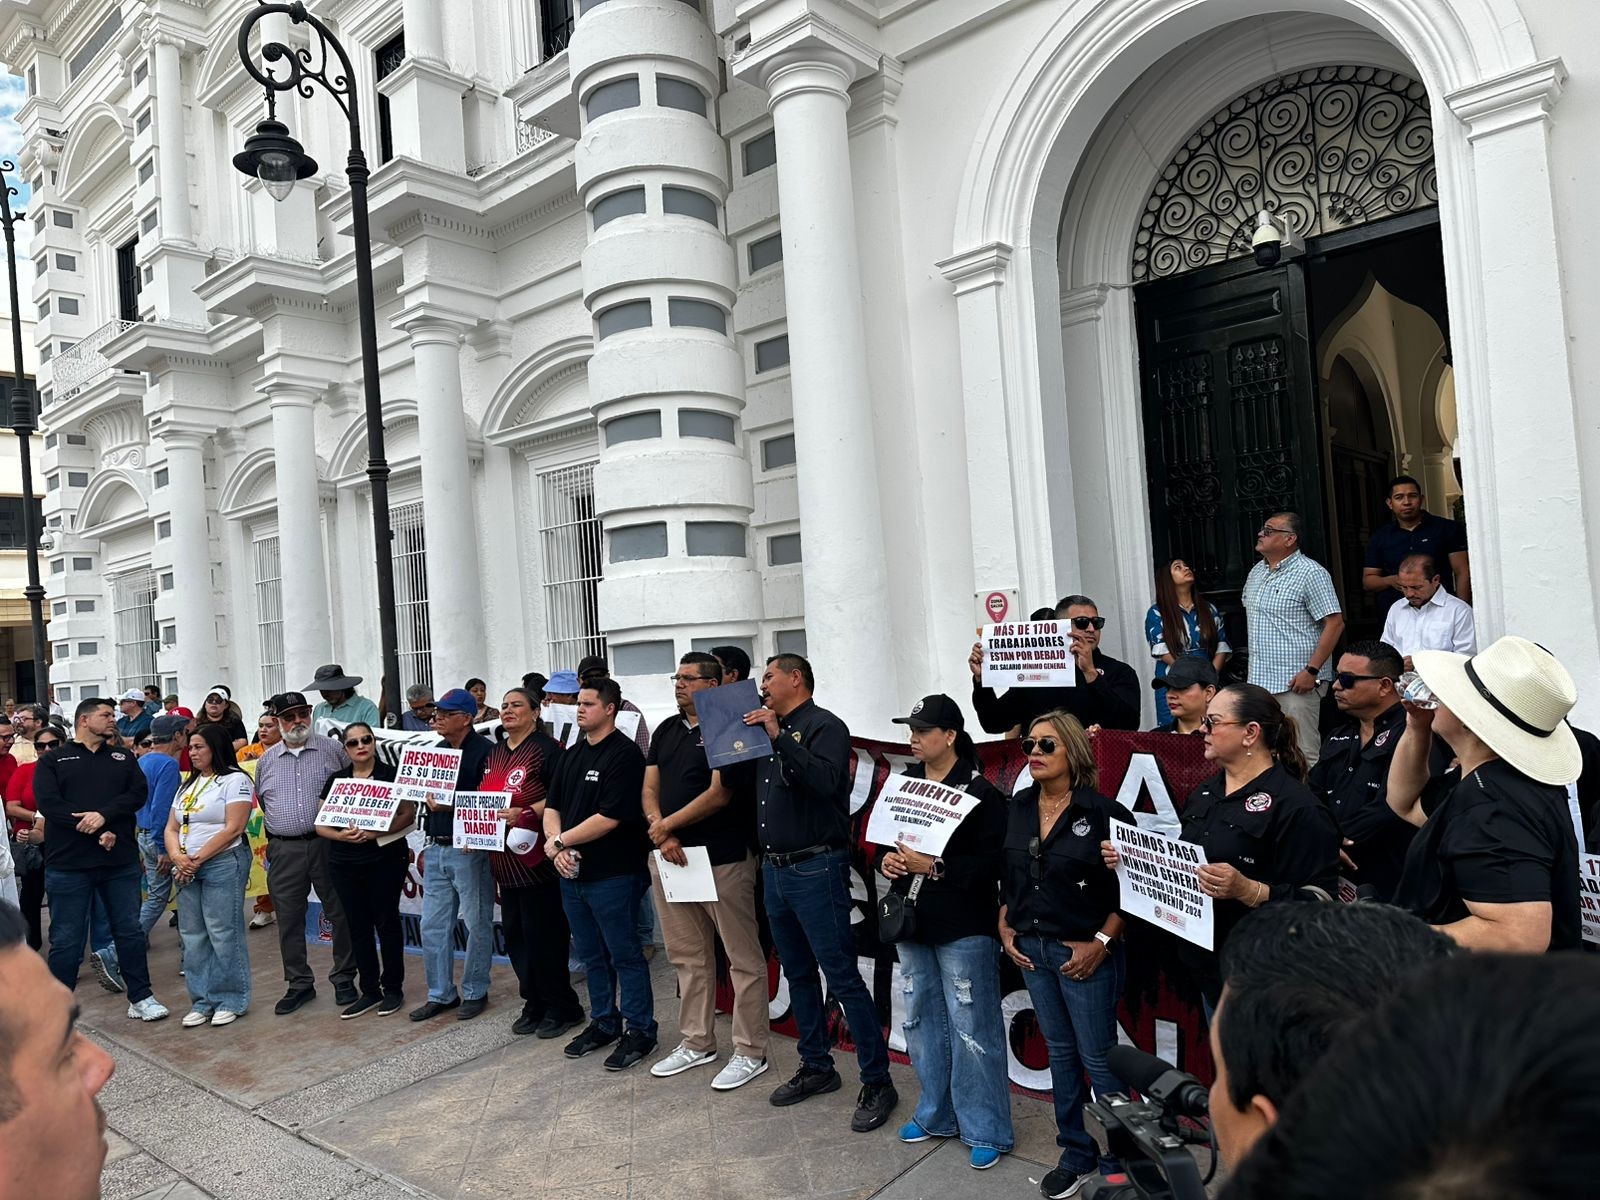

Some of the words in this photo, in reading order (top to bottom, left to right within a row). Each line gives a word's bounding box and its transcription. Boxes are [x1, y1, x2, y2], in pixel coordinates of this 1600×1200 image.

[993, 623, 1014, 636] MÁS
[1018, 624, 1029, 635] DE
[1033, 623, 1057, 635] 1700
[988, 636, 1064, 649] TRABAJADORES
[990, 652, 1014, 661] ESTAN
[1016, 651, 1032, 660] POR
[1034, 650, 1065, 660] DEBAJO
[403, 751, 459, 769] ¡RESPONDER
[401, 766, 412, 776] ES
[417, 767, 428, 777] SU
[432, 769, 456, 781] DEBER!
[332, 783, 397, 800] ¡RESPONDE
[899, 780, 962, 806] AUMENTO
[328, 796, 339, 804] ES
[343, 796, 356, 805] SU
[359, 798, 394, 809] DEBER!
[894, 796, 924, 809] PRESTACIÓN
[908, 816, 932, 827] ALIMENTOS
[912, 809, 927, 819] COSTO
[927, 812, 946, 824] ACTUAL
[464, 822, 496, 835] DIARIO!
[1116, 825, 1165, 855] EXIGIMOS
[1167, 841, 1199, 864] PAGÓ
[1121, 844, 1154, 862] INMEDIATO
[1155, 856, 1167, 866] DEL
[1120, 854, 1158, 877] MÍNIMO
[1127, 870, 1165, 891] CUMPLIENDO
[1165, 884, 1173, 893] LO
[1175, 887, 1203, 906] PACTADO
[1132, 883, 1139, 892] EN
[1140, 886, 1146, 895] EL
[1147, 887, 1184, 911] CONVENIO
[1185, 904, 1202, 919] 2024
